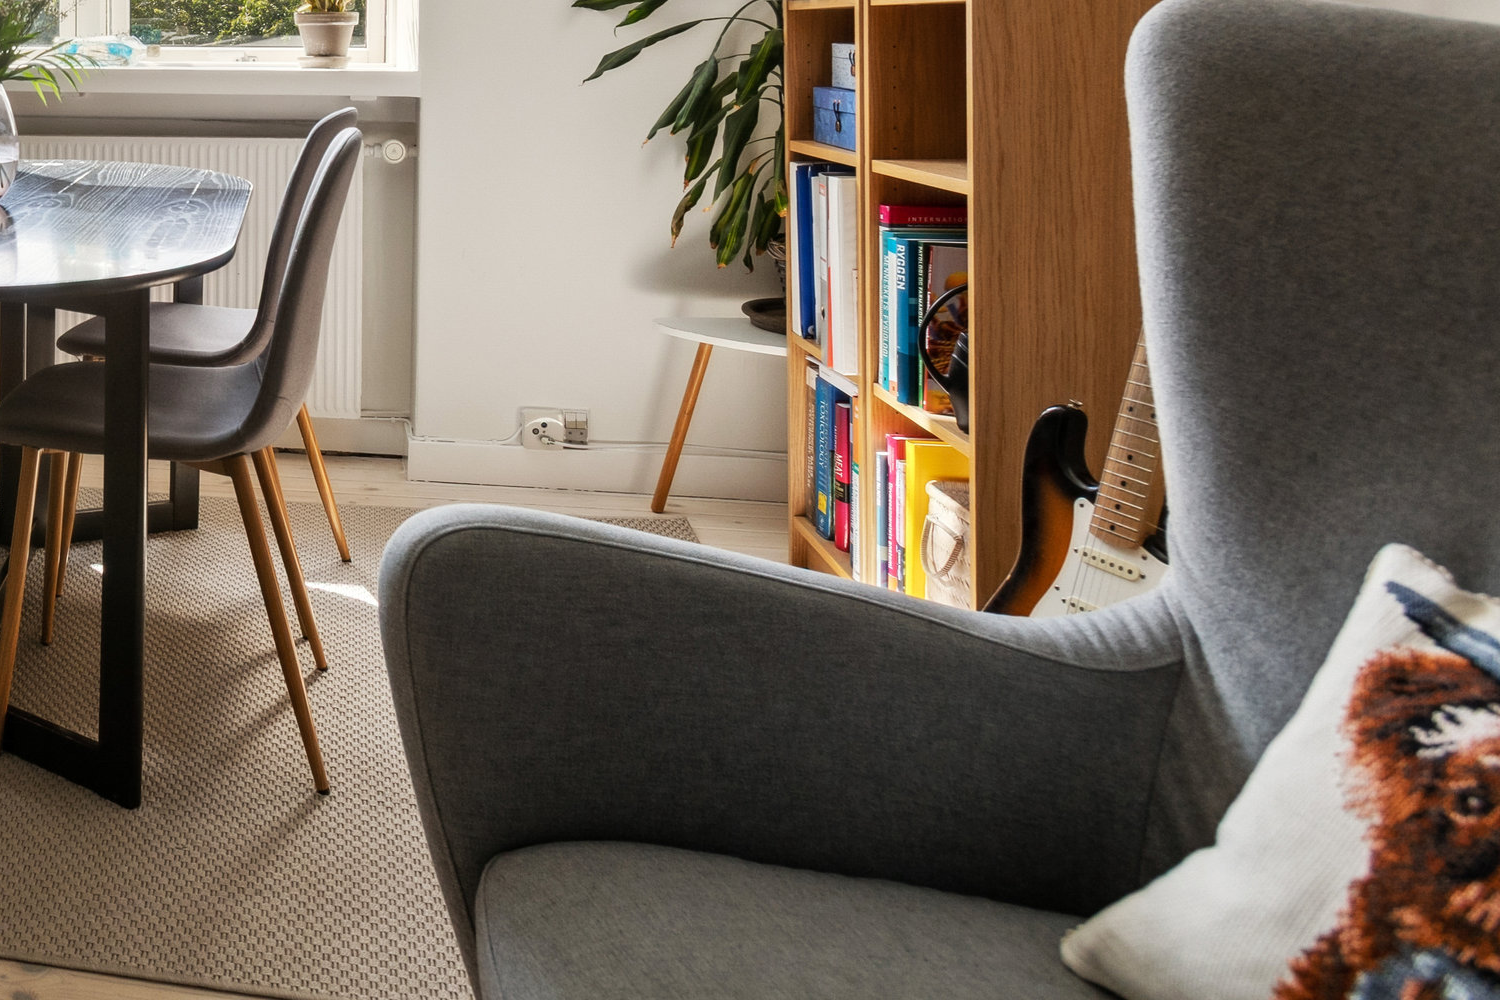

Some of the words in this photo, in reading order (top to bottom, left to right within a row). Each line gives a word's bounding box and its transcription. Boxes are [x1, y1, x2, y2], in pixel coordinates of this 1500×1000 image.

[896, 244, 906, 291] RYGGEN
[818, 400, 826, 469] TOXICOLOGY
[835, 453, 843, 477] MEAT
